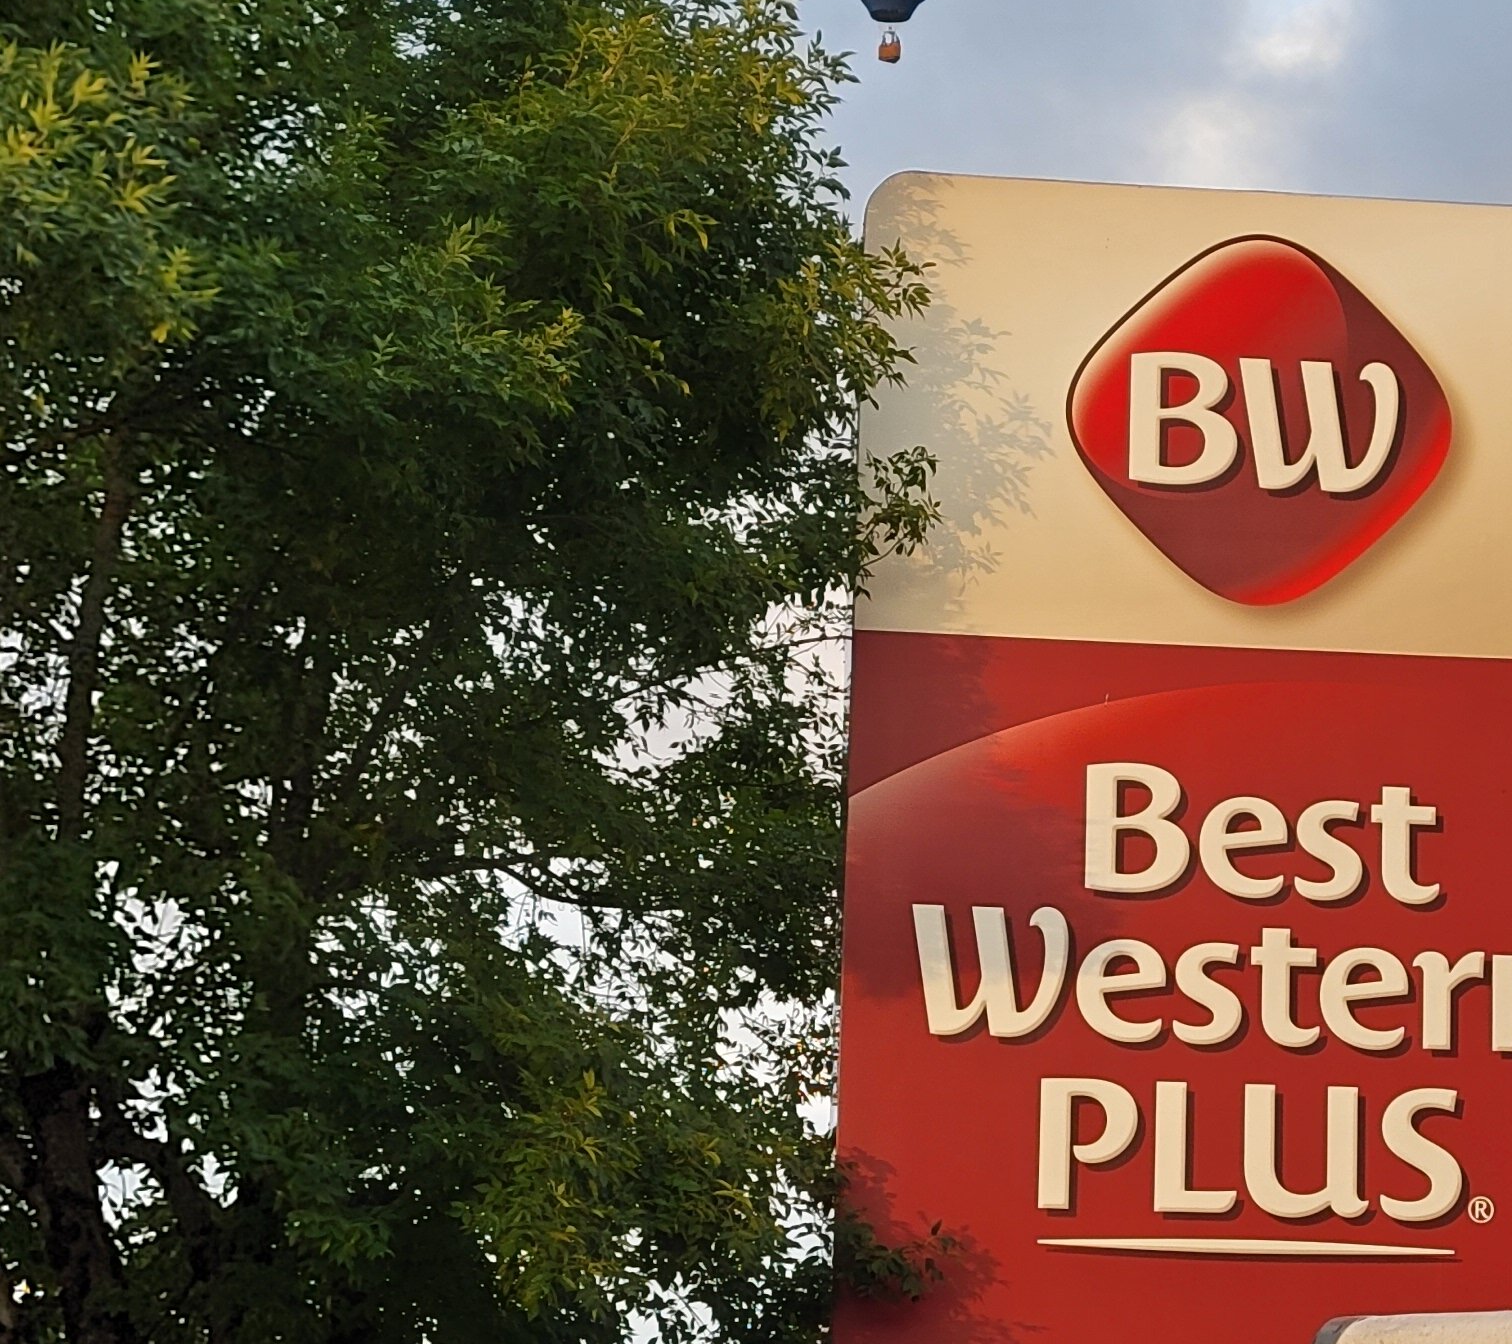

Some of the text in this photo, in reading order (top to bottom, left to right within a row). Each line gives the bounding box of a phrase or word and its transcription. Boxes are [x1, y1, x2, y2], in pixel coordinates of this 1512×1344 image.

[1128, 351, 1398, 494] BW
[1084, 762, 1442, 906] Best
[1037, 1077, 1464, 1223] PLUS
